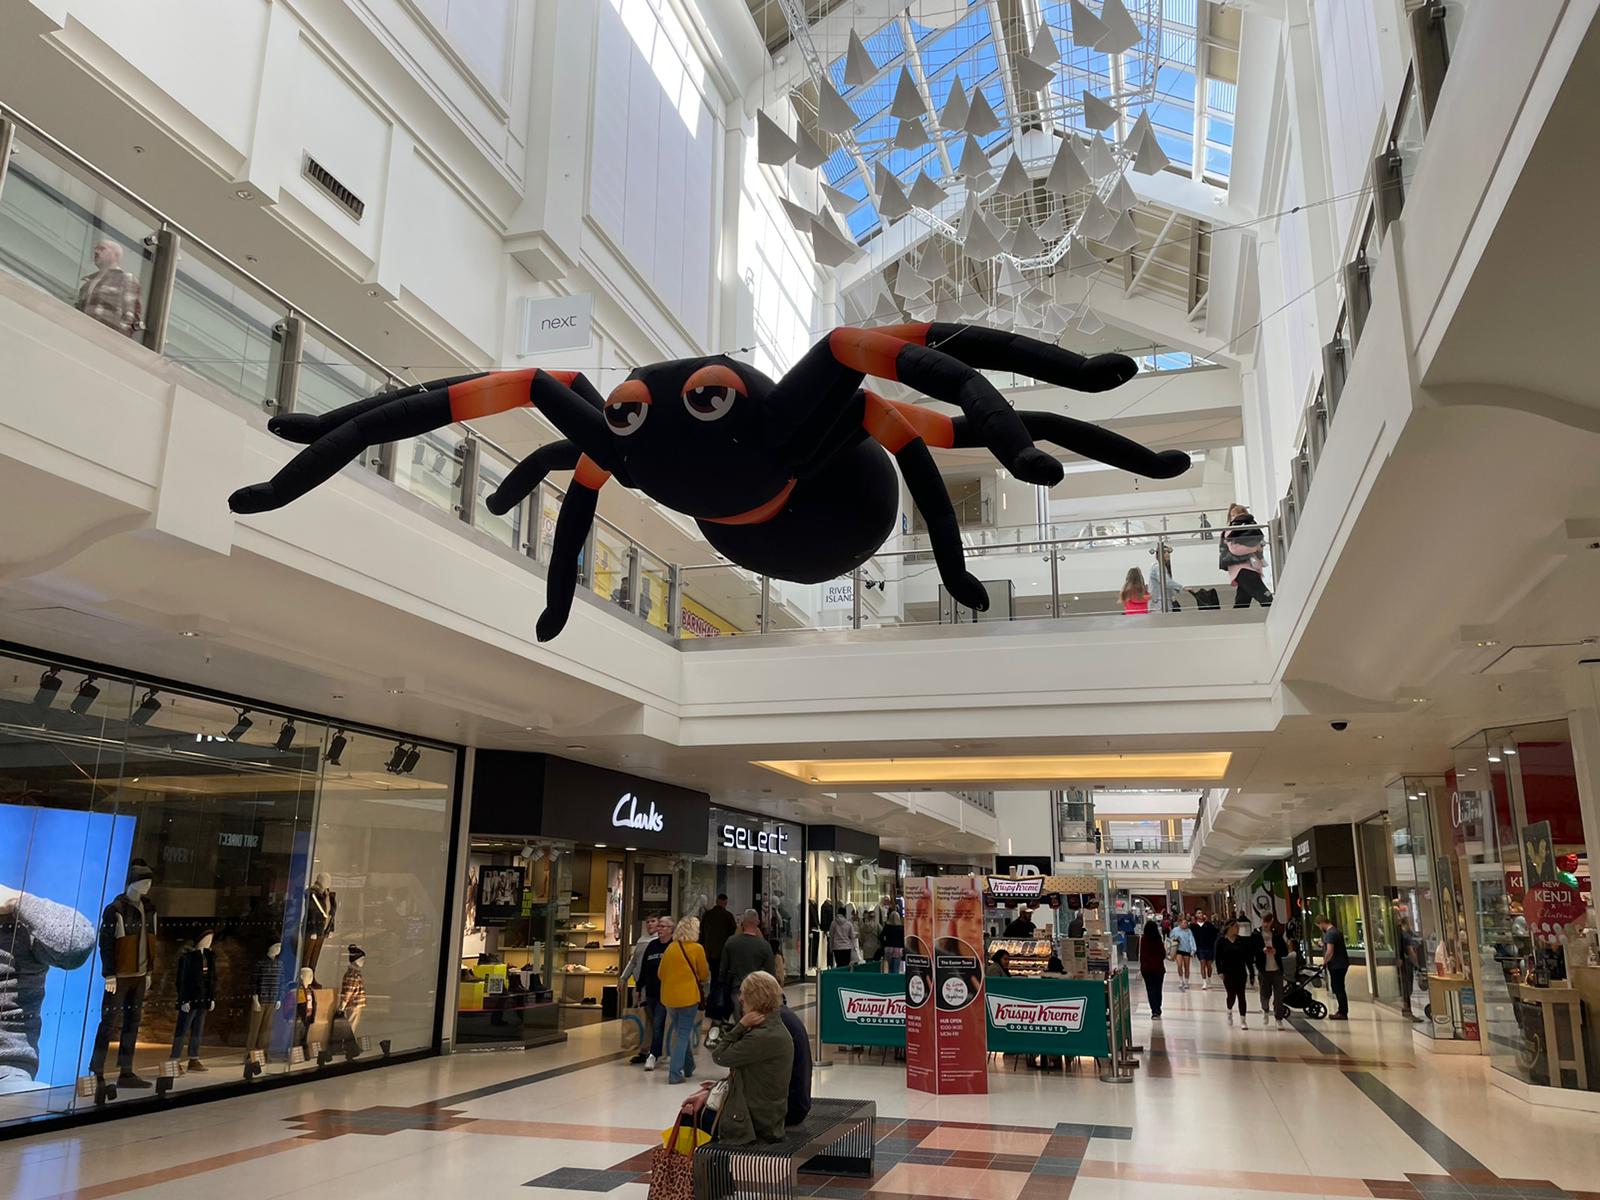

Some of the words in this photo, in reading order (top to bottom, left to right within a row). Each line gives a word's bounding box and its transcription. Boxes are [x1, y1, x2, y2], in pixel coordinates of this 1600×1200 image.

[541, 315, 577, 330] next
[829, 586, 853, 595] RIVER
[825, 594, 854, 603] ISLAND
[612, 793, 664, 832] Clarks
[1095, 859, 1161, 870] PRIMARK
[993, 882, 1016, 893] Krispy
[1016, 881, 1039, 892] Kreme
[1534, 891, 1572, 903] KENJI
[847, 998, 886, 1016] Krispy
[886, 998, 906, 1014] Kre
[995, 1003, 1037, 1024] Krispy
[1037, 1005, 1080, 1023] Kreme
[1010, 1024, 1064, 1032] DOUGHNUTS
